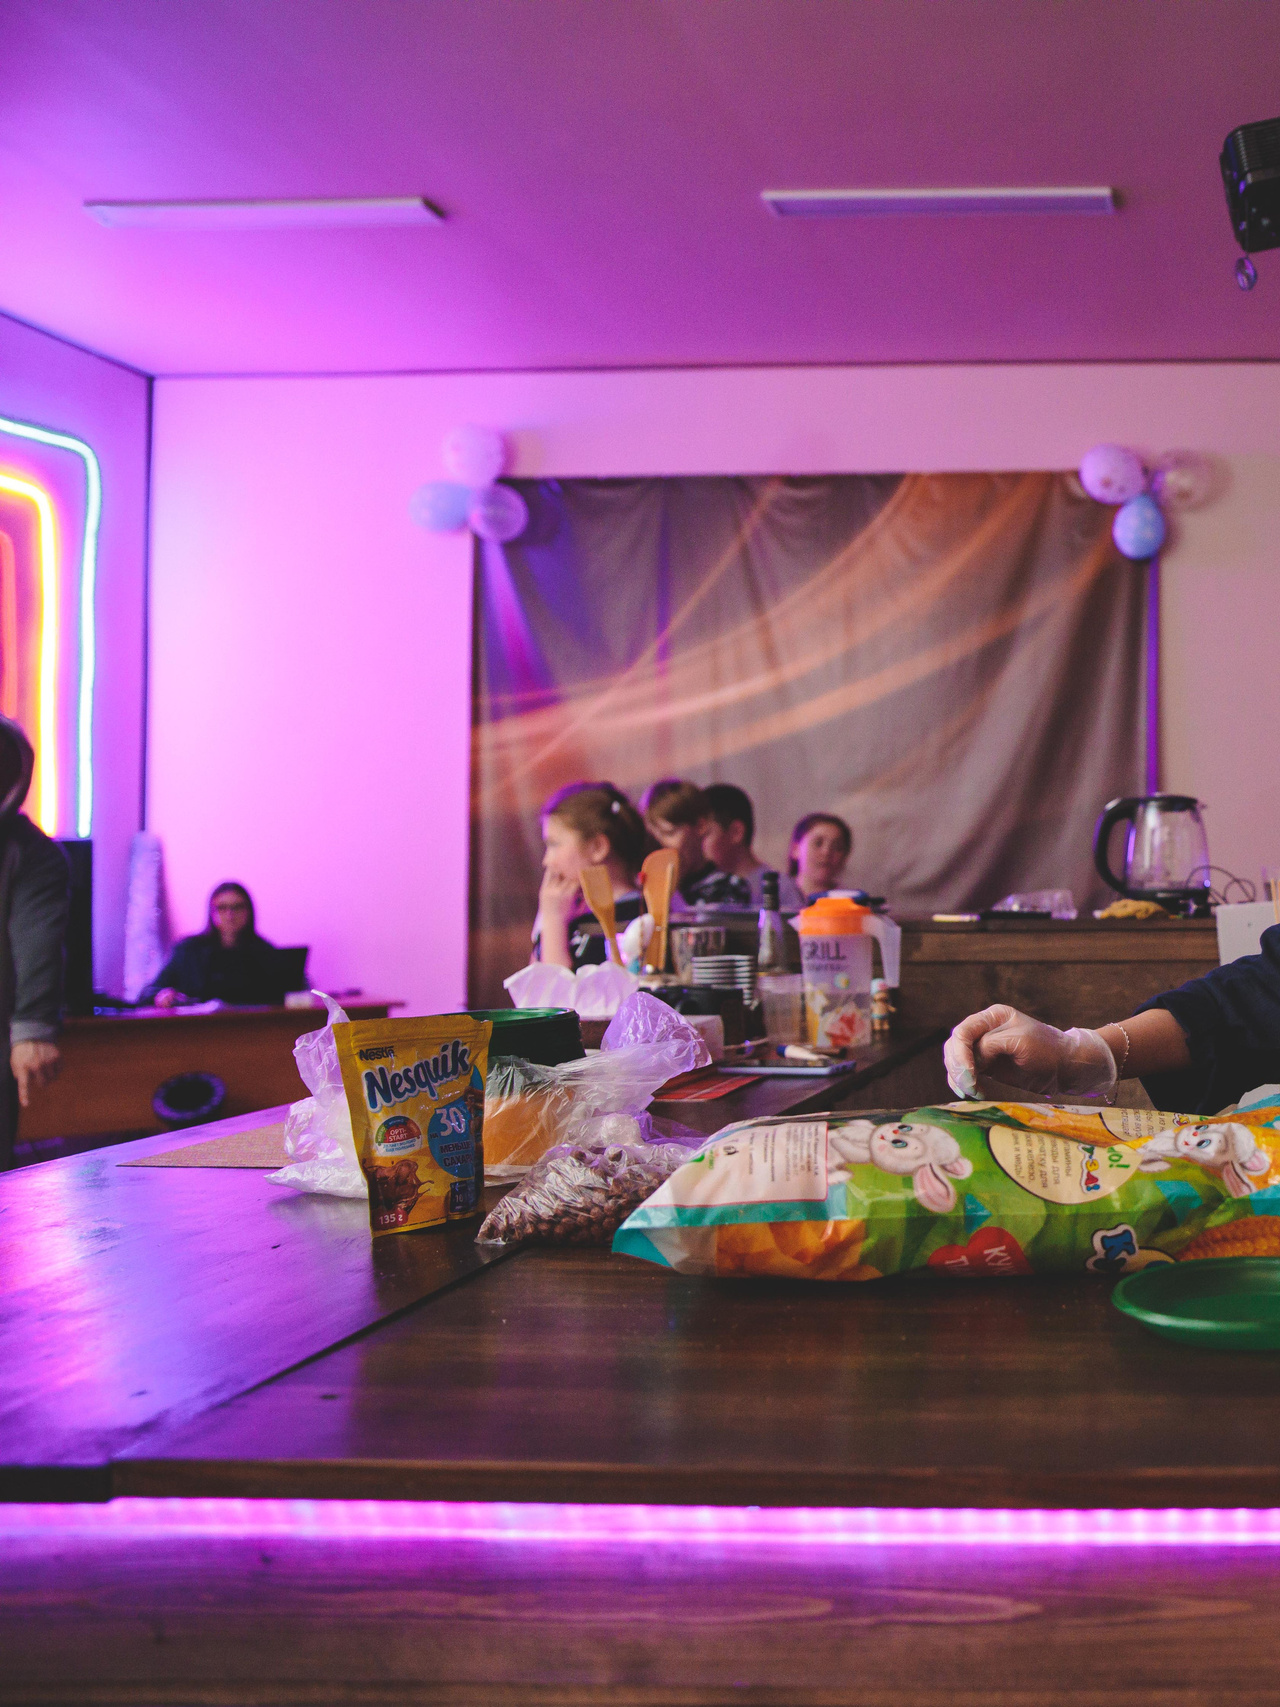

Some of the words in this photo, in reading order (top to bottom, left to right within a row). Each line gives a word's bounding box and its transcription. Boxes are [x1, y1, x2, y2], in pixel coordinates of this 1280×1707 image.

[363, 1039, 470, 1112] Nesquik
[388, 1133, 408, 1142] START
[440, 1141, 472, 1154] МЕНЬШЕ
[379, 1214, 396, 1225] 135
